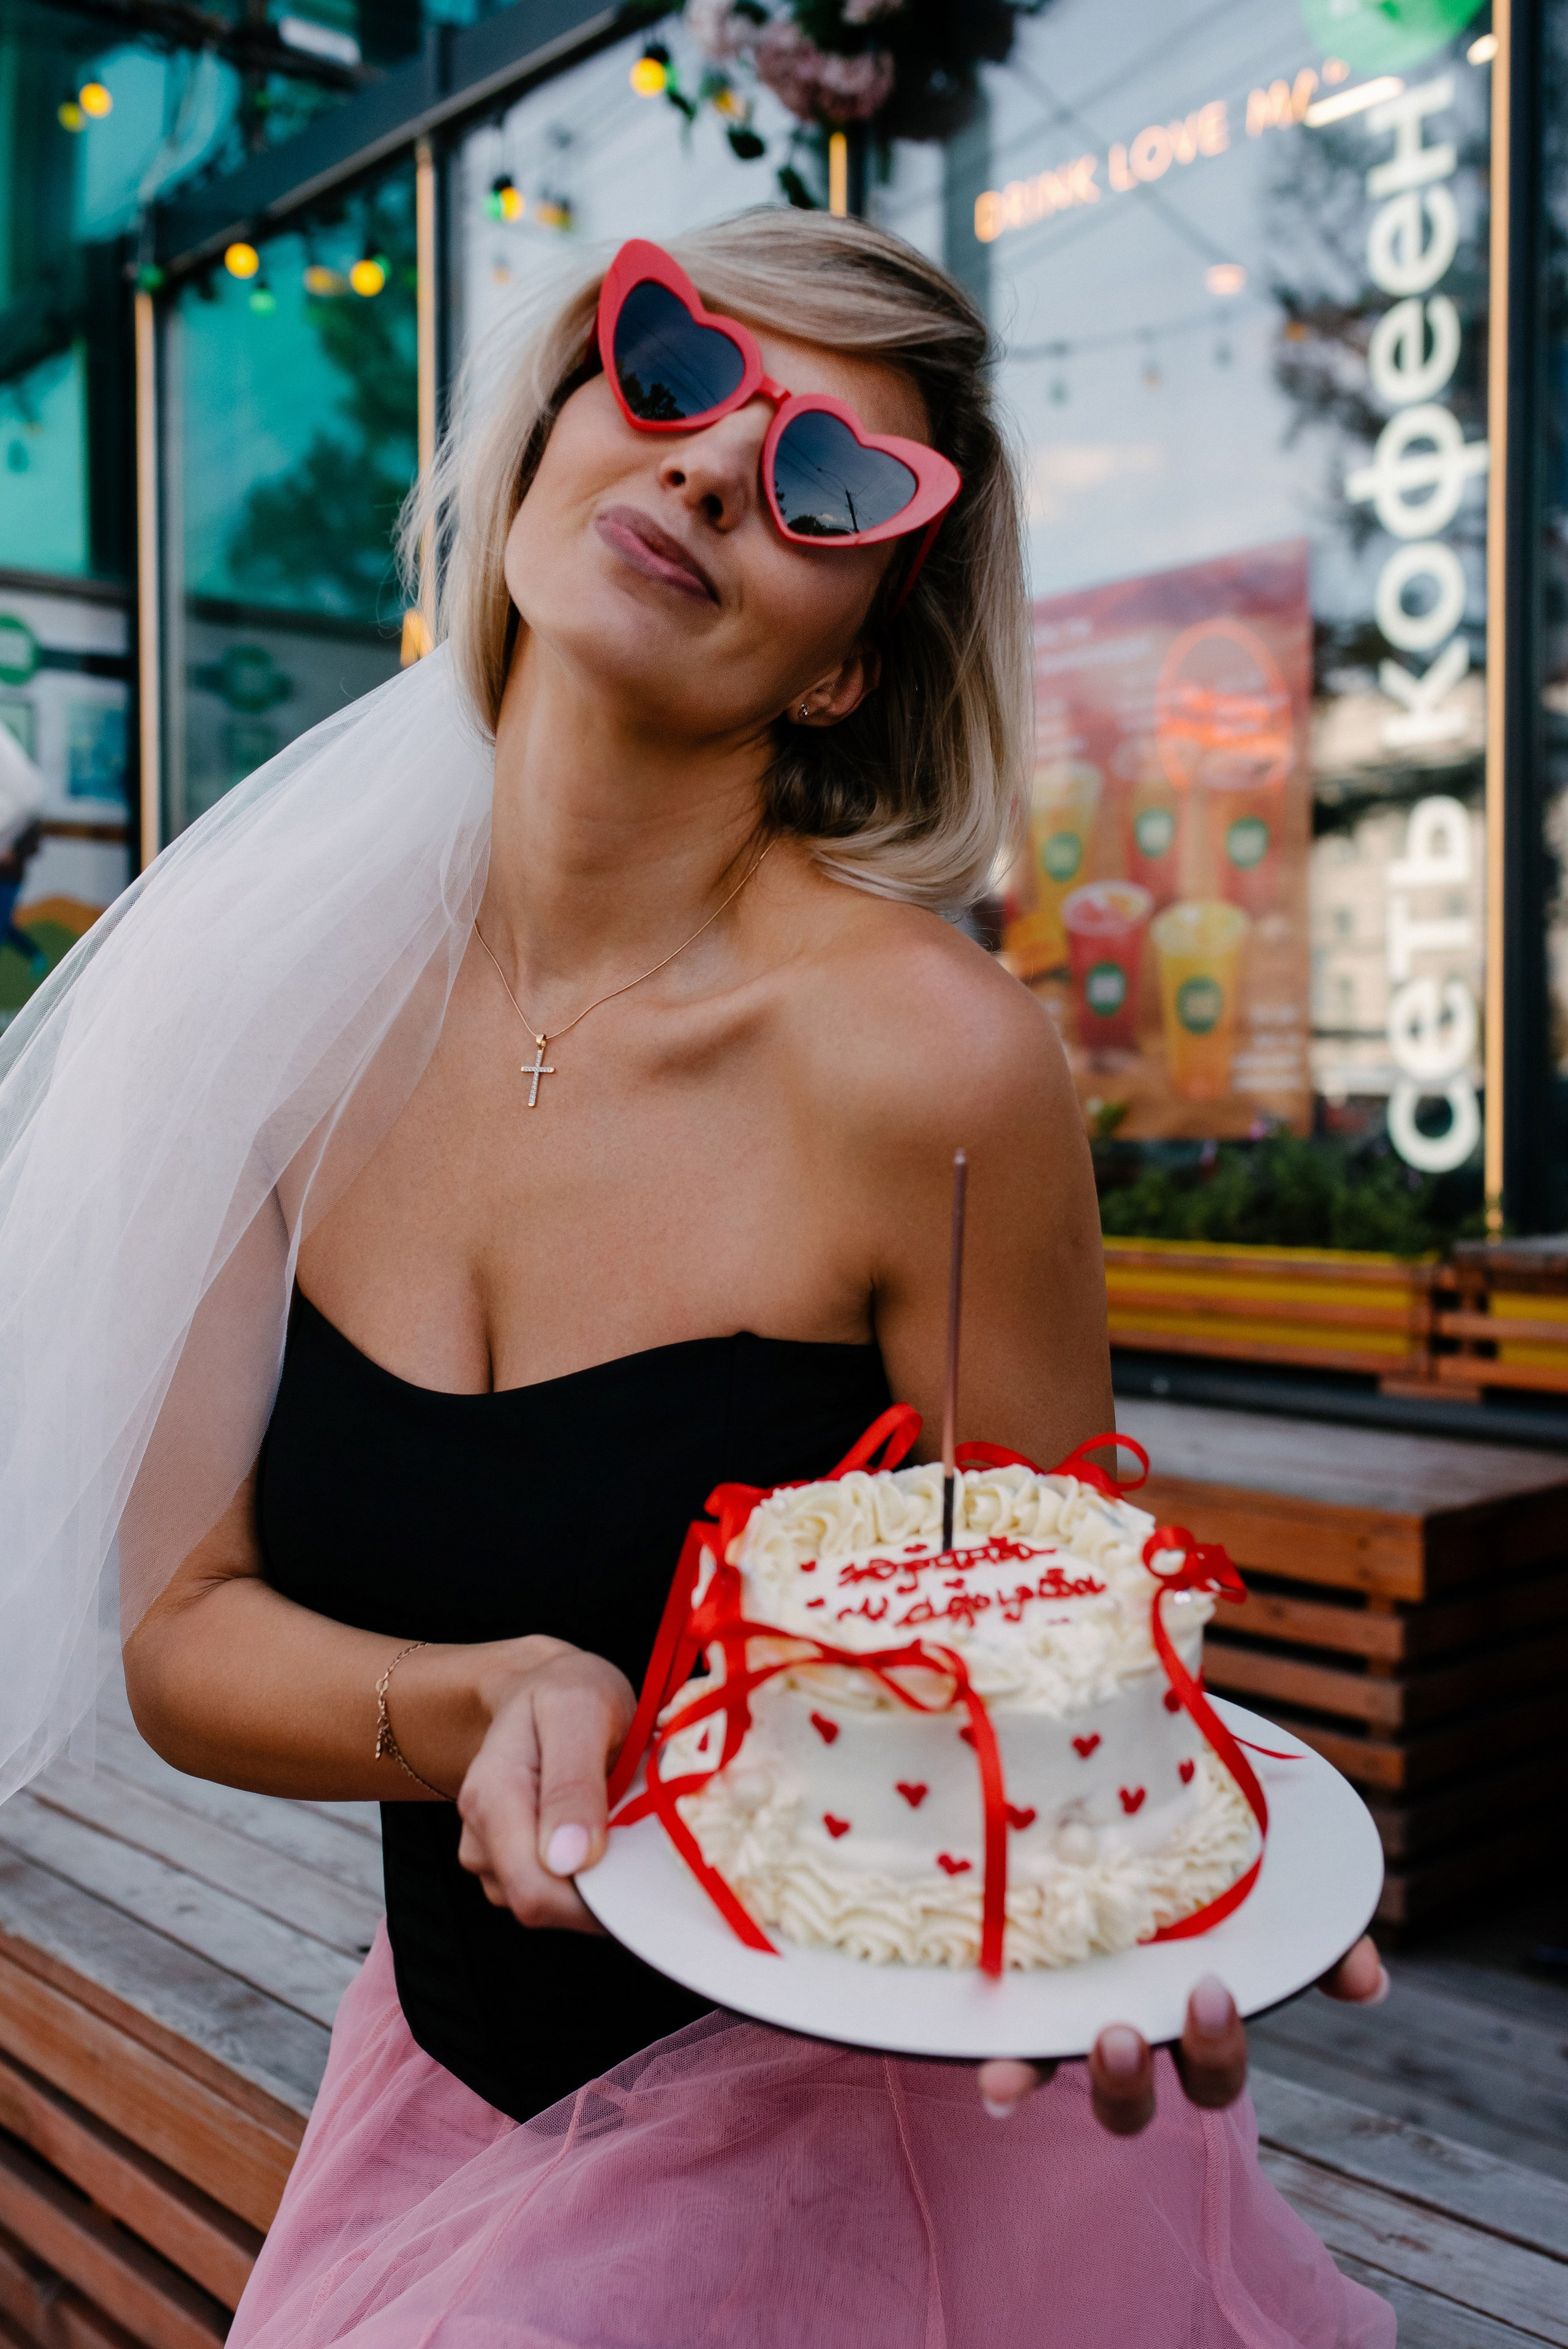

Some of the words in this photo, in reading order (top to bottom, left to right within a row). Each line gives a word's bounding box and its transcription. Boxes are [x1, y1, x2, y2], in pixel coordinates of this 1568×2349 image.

[1109, 100, 1231, 192] LOVE
[1345, 72, 1493, 745] кофеен
[1385, 794, 1482, 1174] сеть
